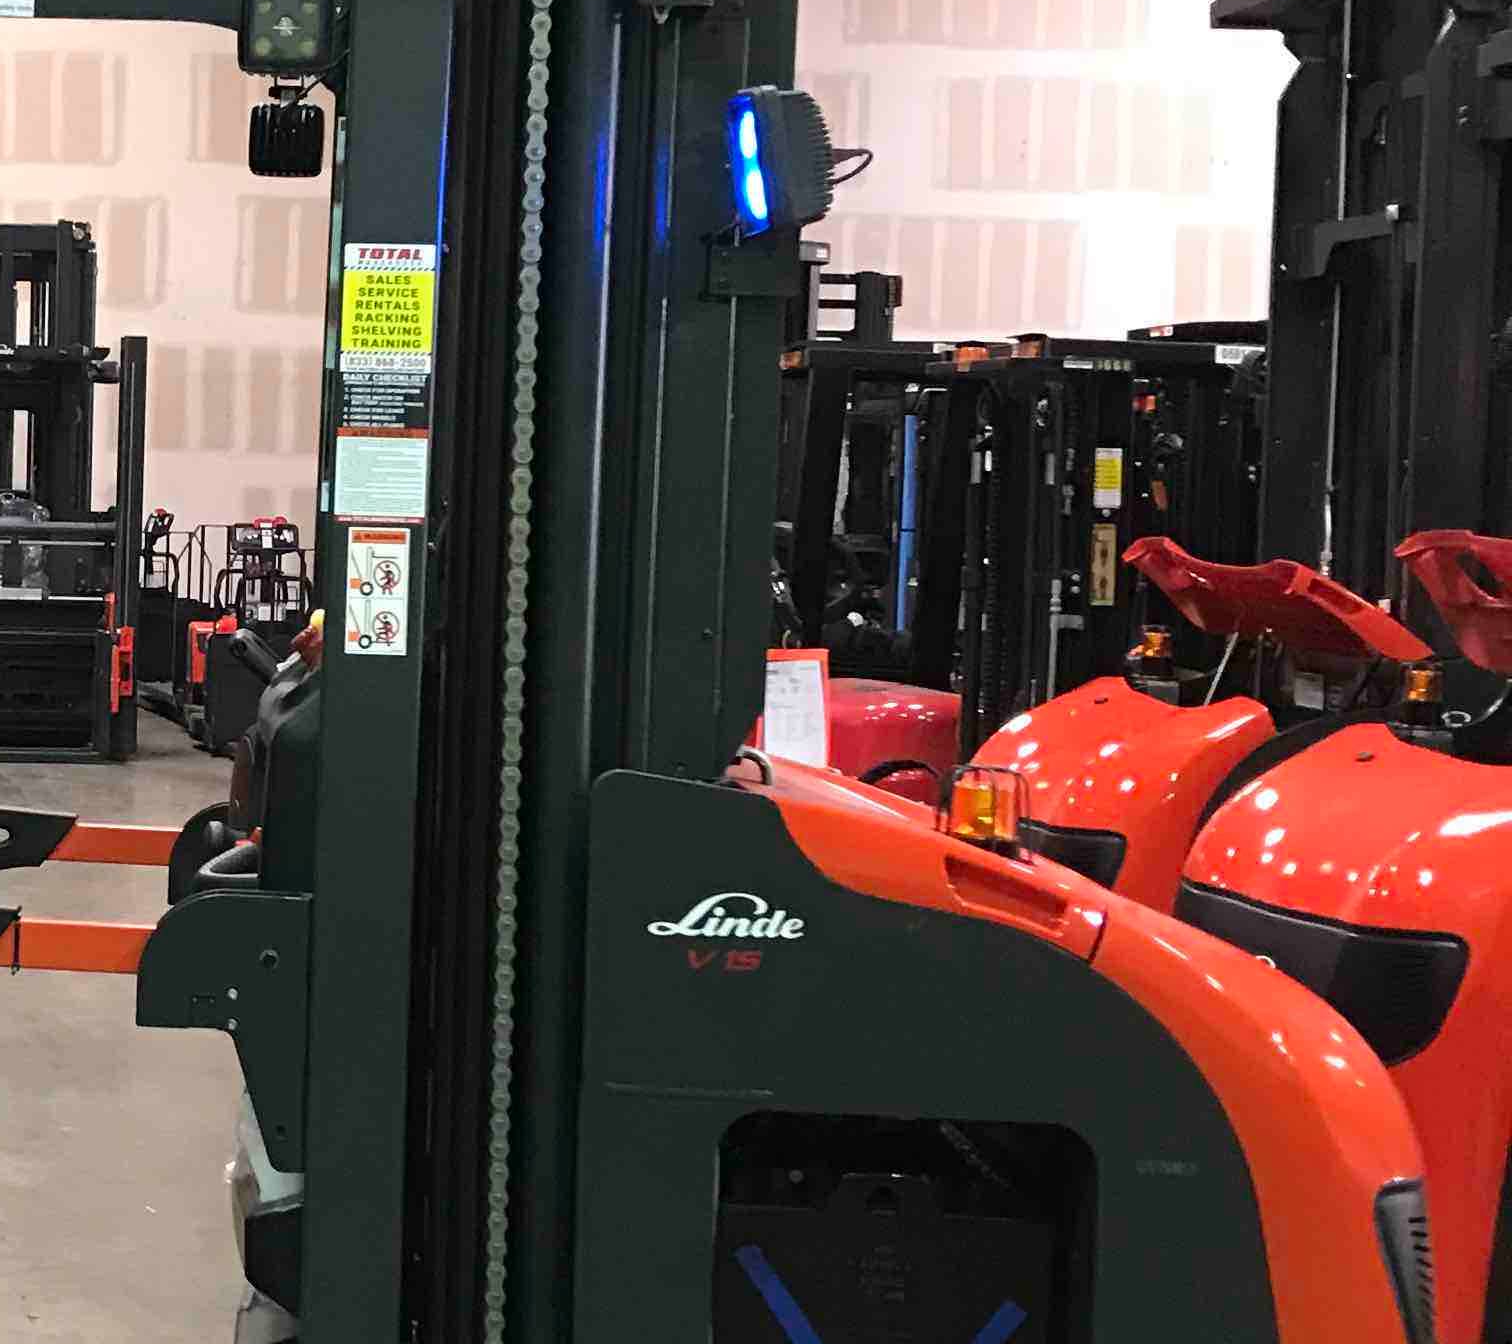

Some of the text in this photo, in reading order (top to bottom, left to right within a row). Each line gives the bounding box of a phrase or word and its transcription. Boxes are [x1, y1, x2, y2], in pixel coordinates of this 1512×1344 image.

[358, 247, 423, 261] TOTAL
[365, 274, 412, 285] SALES
[358, 287, 420, 298] SERVICE
[354, 299, 421, 311] RENTALS
[354, 312, 420, 324] RACKING
[351, 325, 423, 336] SHELVING
[351, 338, 422, 349] TRAINING
[647, 891, 805, 940] Linde
